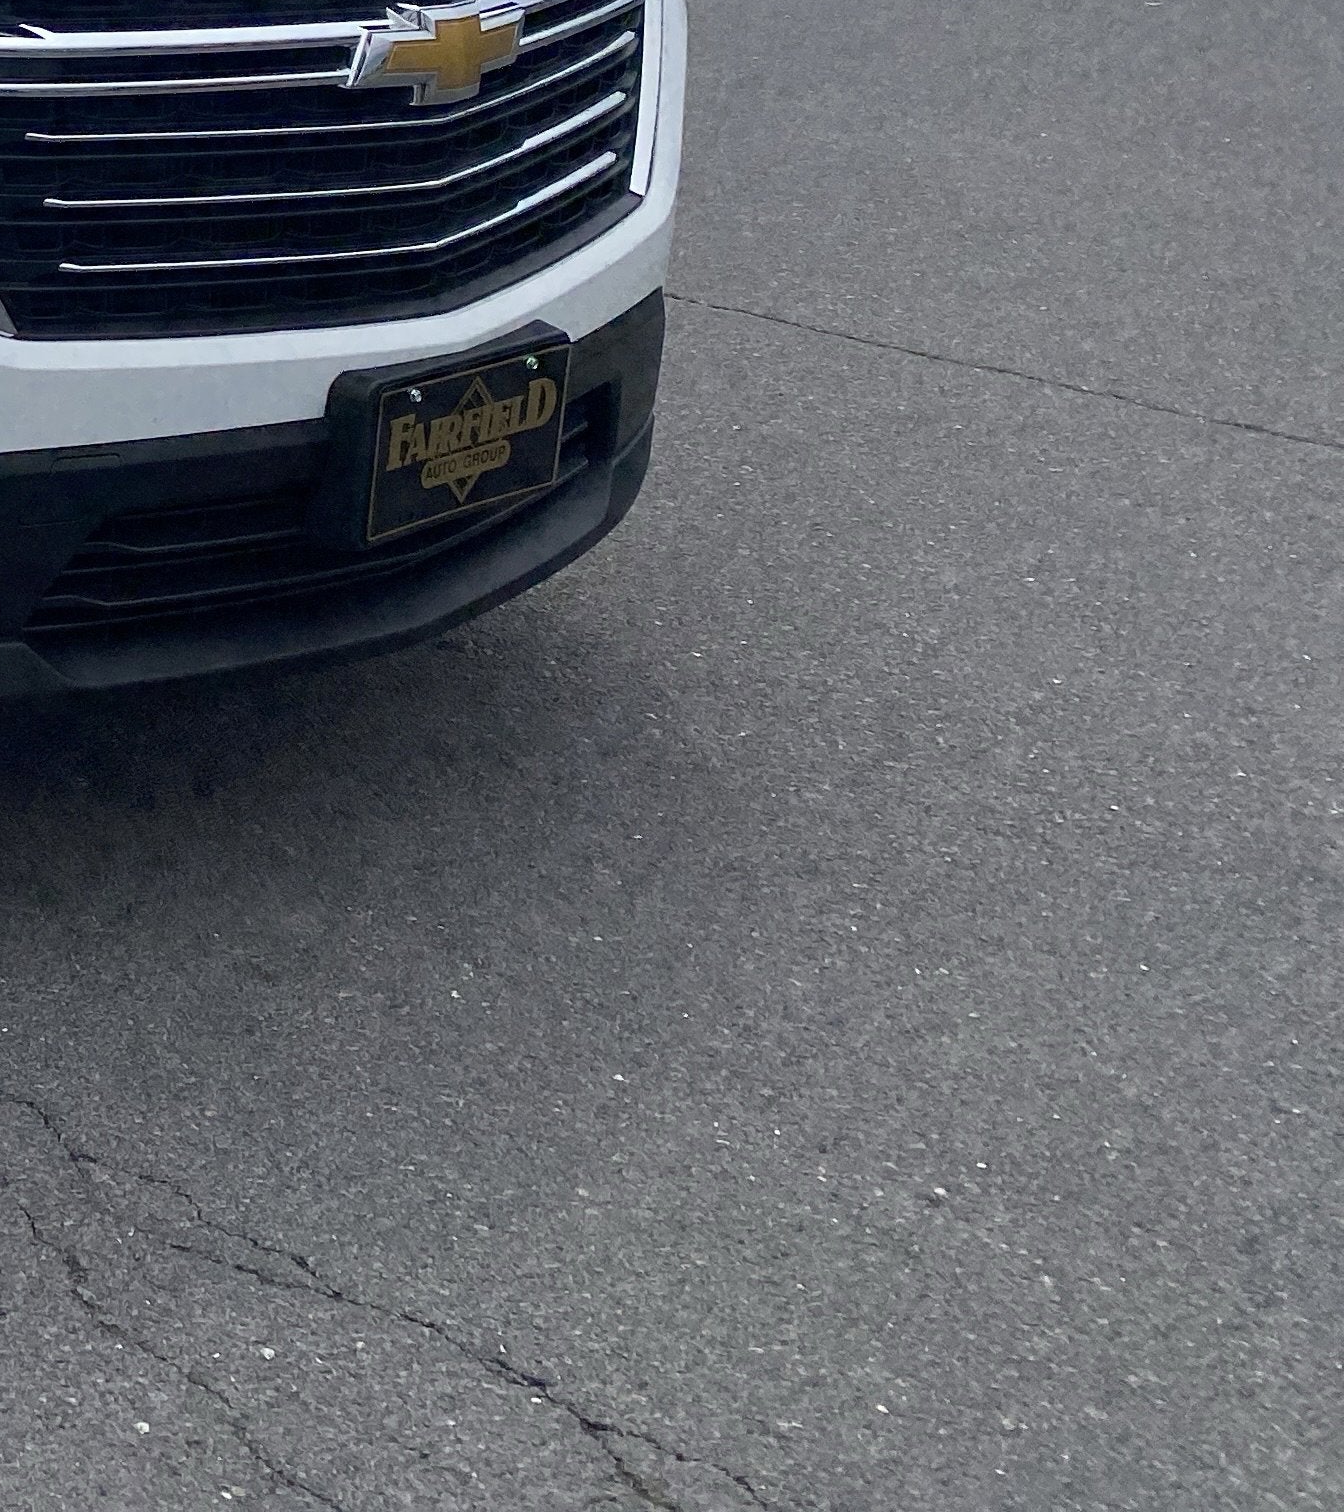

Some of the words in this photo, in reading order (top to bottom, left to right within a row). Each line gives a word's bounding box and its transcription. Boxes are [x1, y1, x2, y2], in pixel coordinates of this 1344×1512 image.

[385, 377, 558, 472] FAIRFIELD
[425, 462, 458, 481] AUTO
[463, 444, 507, 469] GROUP
